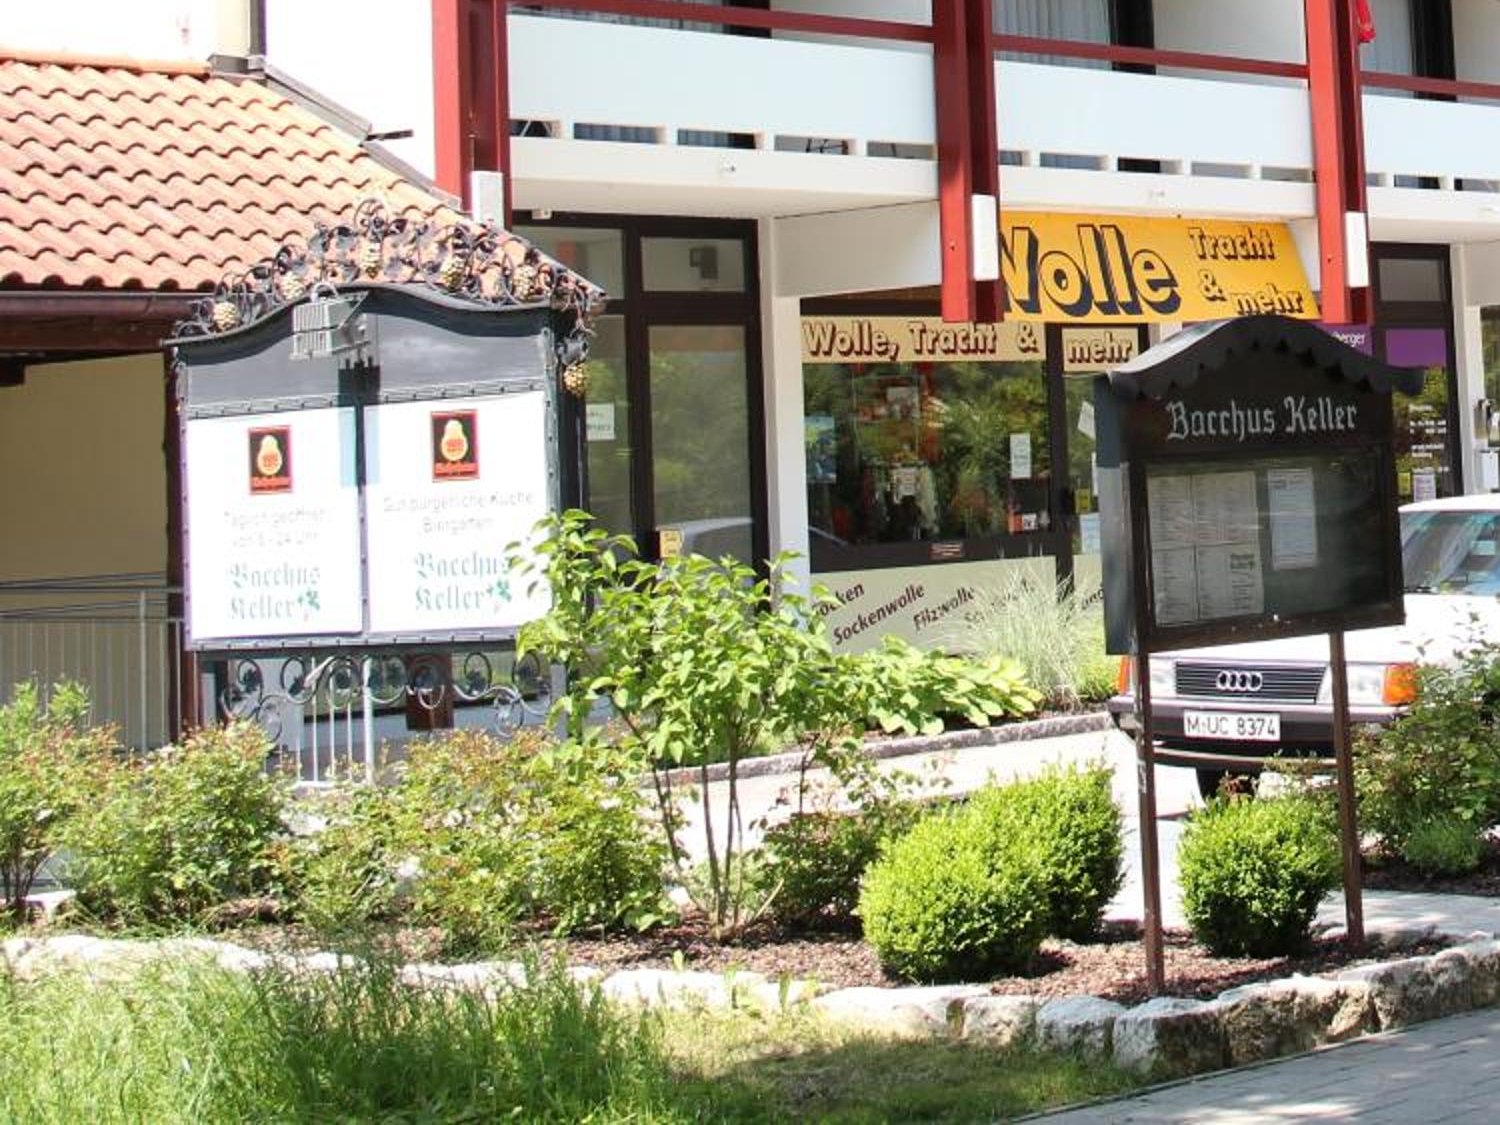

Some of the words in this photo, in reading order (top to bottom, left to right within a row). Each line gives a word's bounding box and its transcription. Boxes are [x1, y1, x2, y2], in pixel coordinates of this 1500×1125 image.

[1188, 225, 1276, 260] Tracht
[1198, 268, 1227, 302] &
[1229, 282, 1305, 315] mehr
[801, 319, 900, 361] Wolle,
[909, 321, 997, 355] Tracht
[1018, 321, 1040, 353] &
[1068, 331, 1133, 363] mehr
[1165, 398, 1276, 442] Bacchus
[1283, 395, 1358, 434] Keller
[832, 582, 925, 646] Sockenwolle
[1237, 716, 1276, 736] 8374
